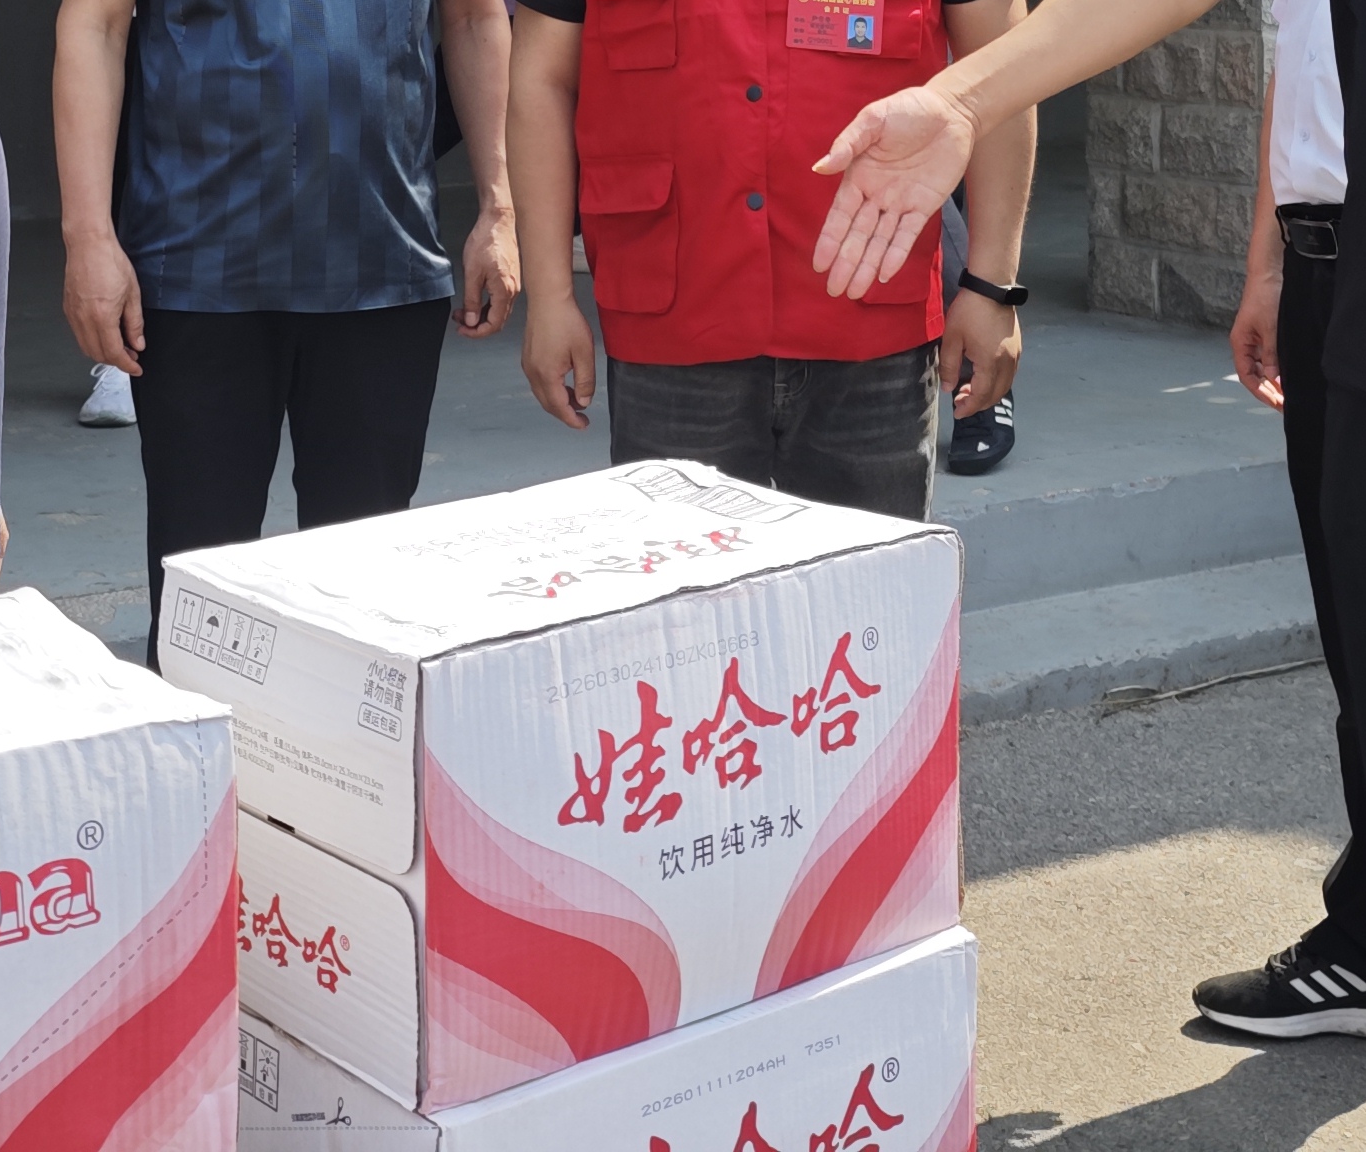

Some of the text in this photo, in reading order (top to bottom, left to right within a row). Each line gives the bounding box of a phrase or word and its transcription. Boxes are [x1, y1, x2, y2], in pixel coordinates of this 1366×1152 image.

[557, 632, 882, 834] 娃哈哈
[658, 805, 804, 881] 饮用纯净水
[641, 1054, 787, 1118] 202601111204AH
[804, 1034, 842, 1056] 7351
